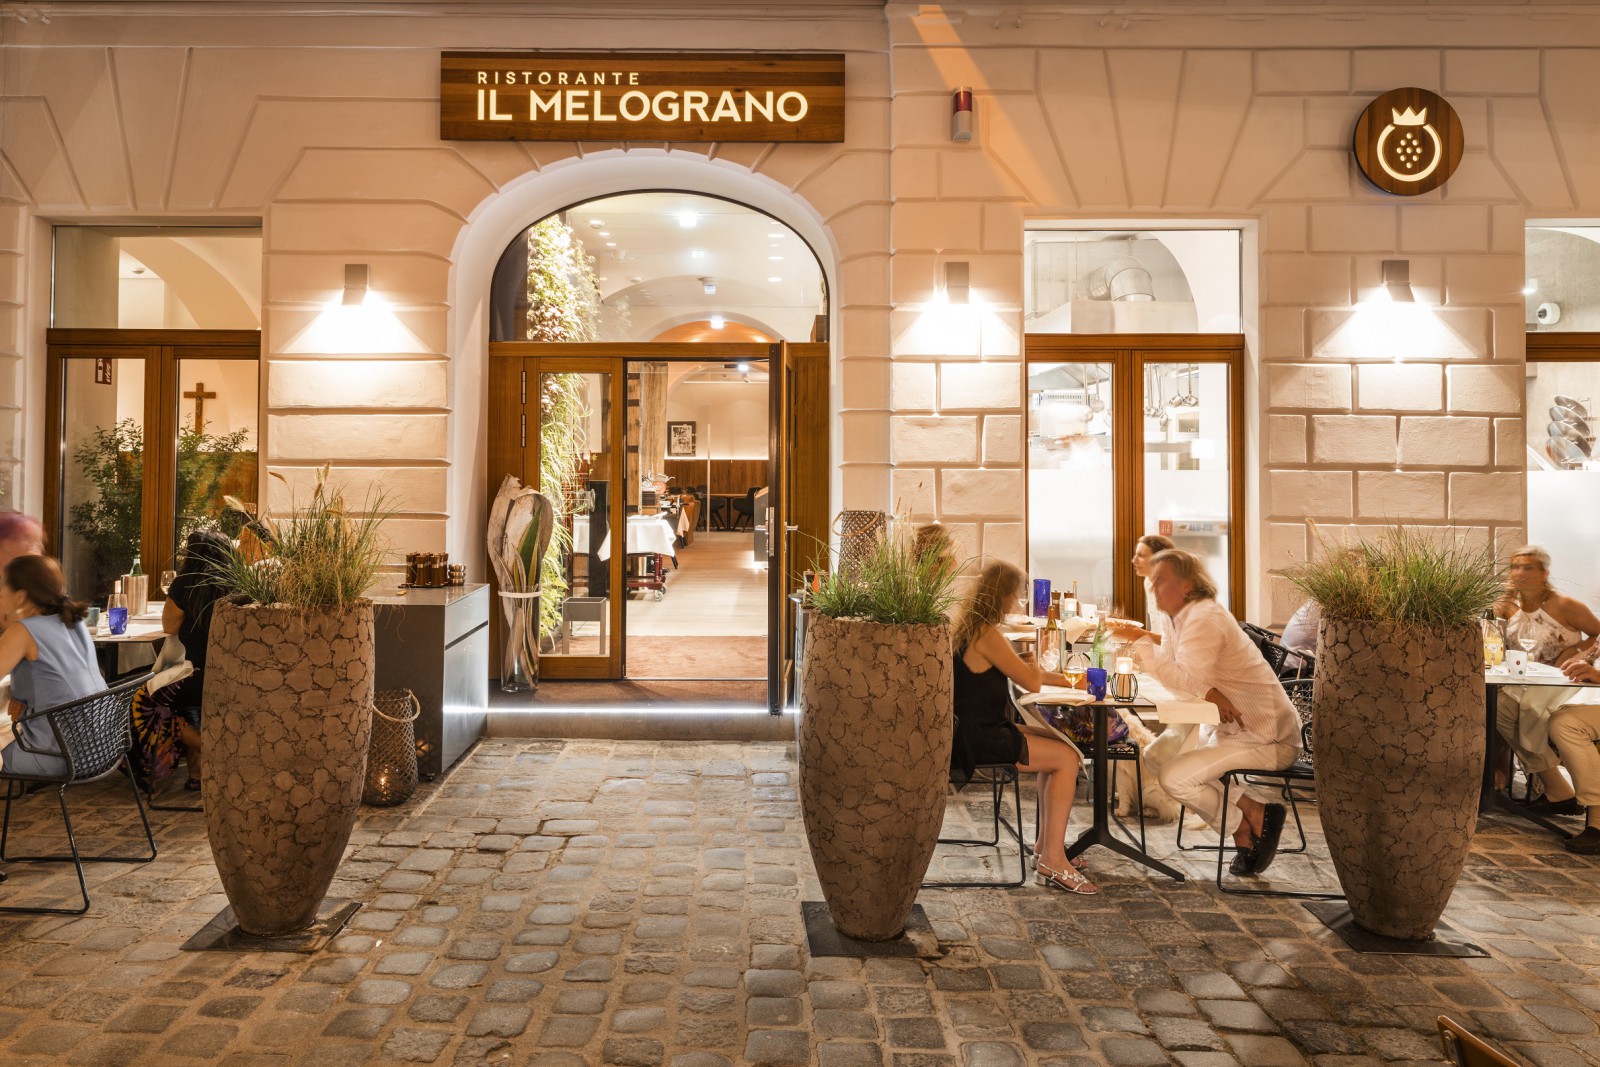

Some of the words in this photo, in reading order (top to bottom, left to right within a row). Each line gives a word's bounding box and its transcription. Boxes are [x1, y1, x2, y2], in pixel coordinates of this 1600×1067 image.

[477, 71, 640, 85] RISTORANTE
[477, 89, 513, 121] IL
[529, 90, 809, 122] MELOGRANO
